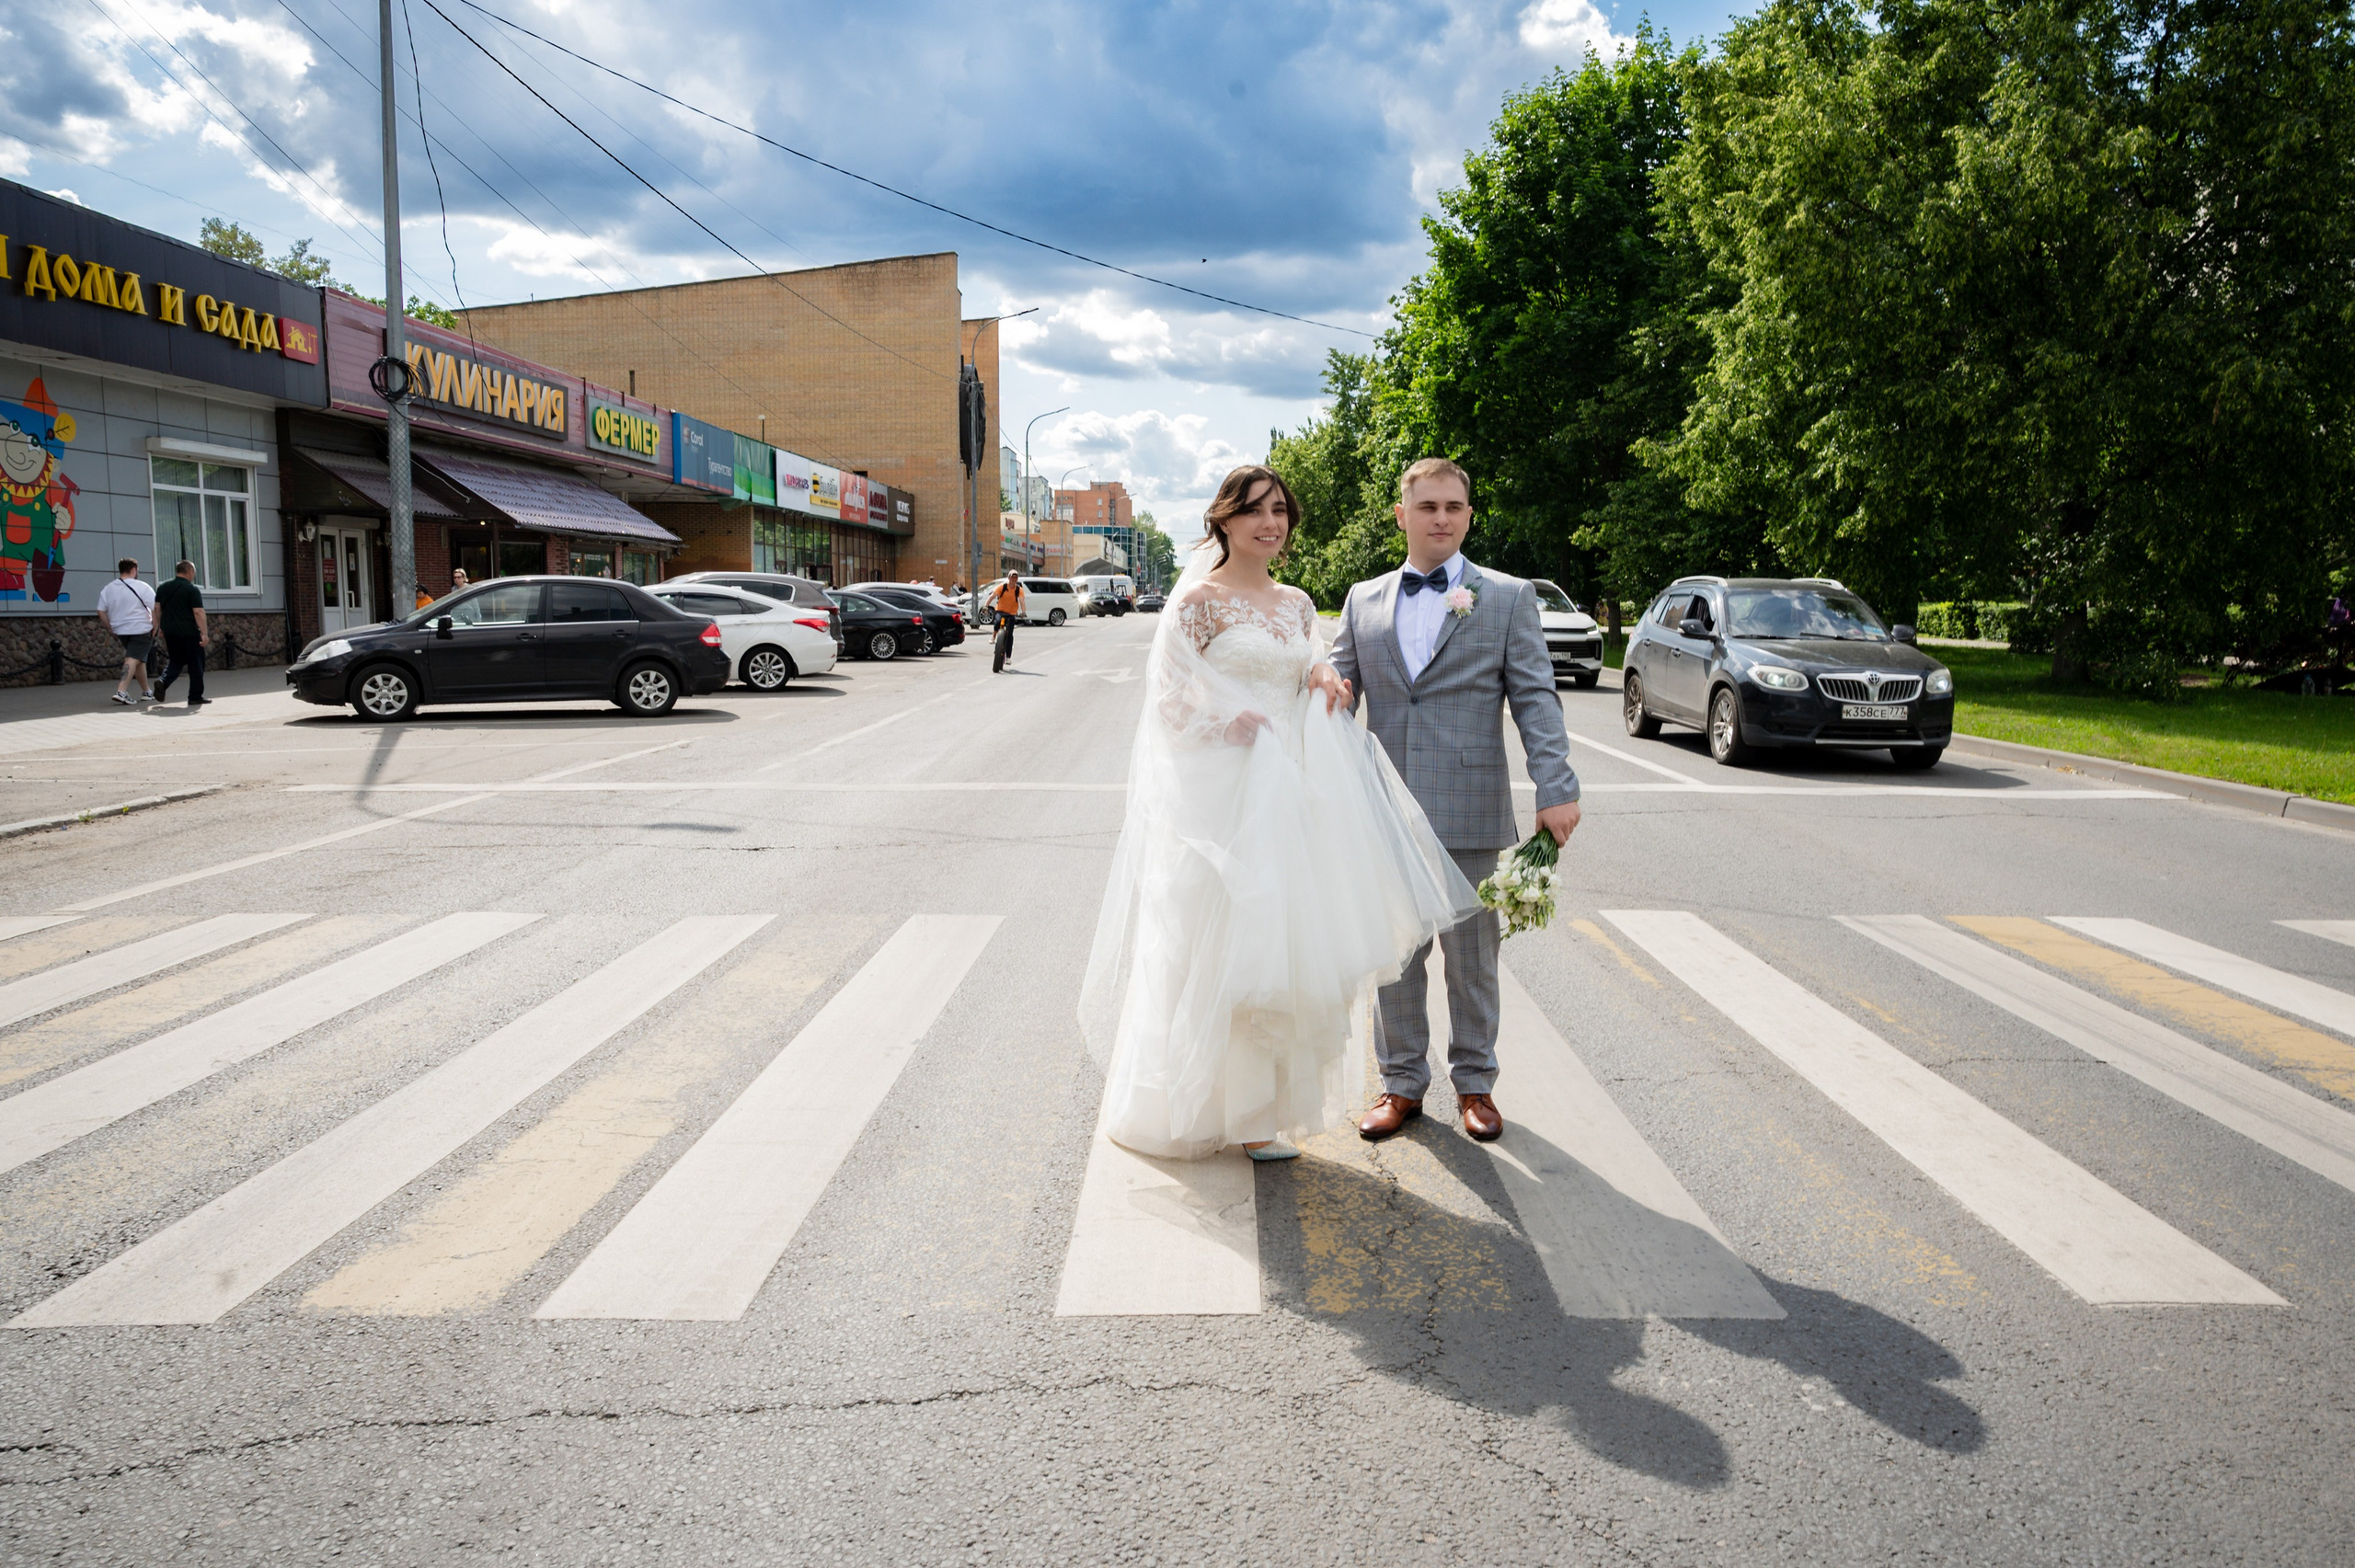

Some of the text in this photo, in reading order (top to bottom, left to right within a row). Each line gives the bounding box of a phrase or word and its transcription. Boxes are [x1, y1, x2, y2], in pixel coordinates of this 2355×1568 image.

[24, 244, 148, 315] ДОМА
[157, 281, 187, 326] И
[195, 293, 281, 354] САДА
[405, 340, 564, 433] КУЛИНАРИЯ
[592, 406, 661, 456] ФЕРМЕР
[690, 430, 705, 447] Coral
[1845, 706, 1887, 718] К358СЕ
